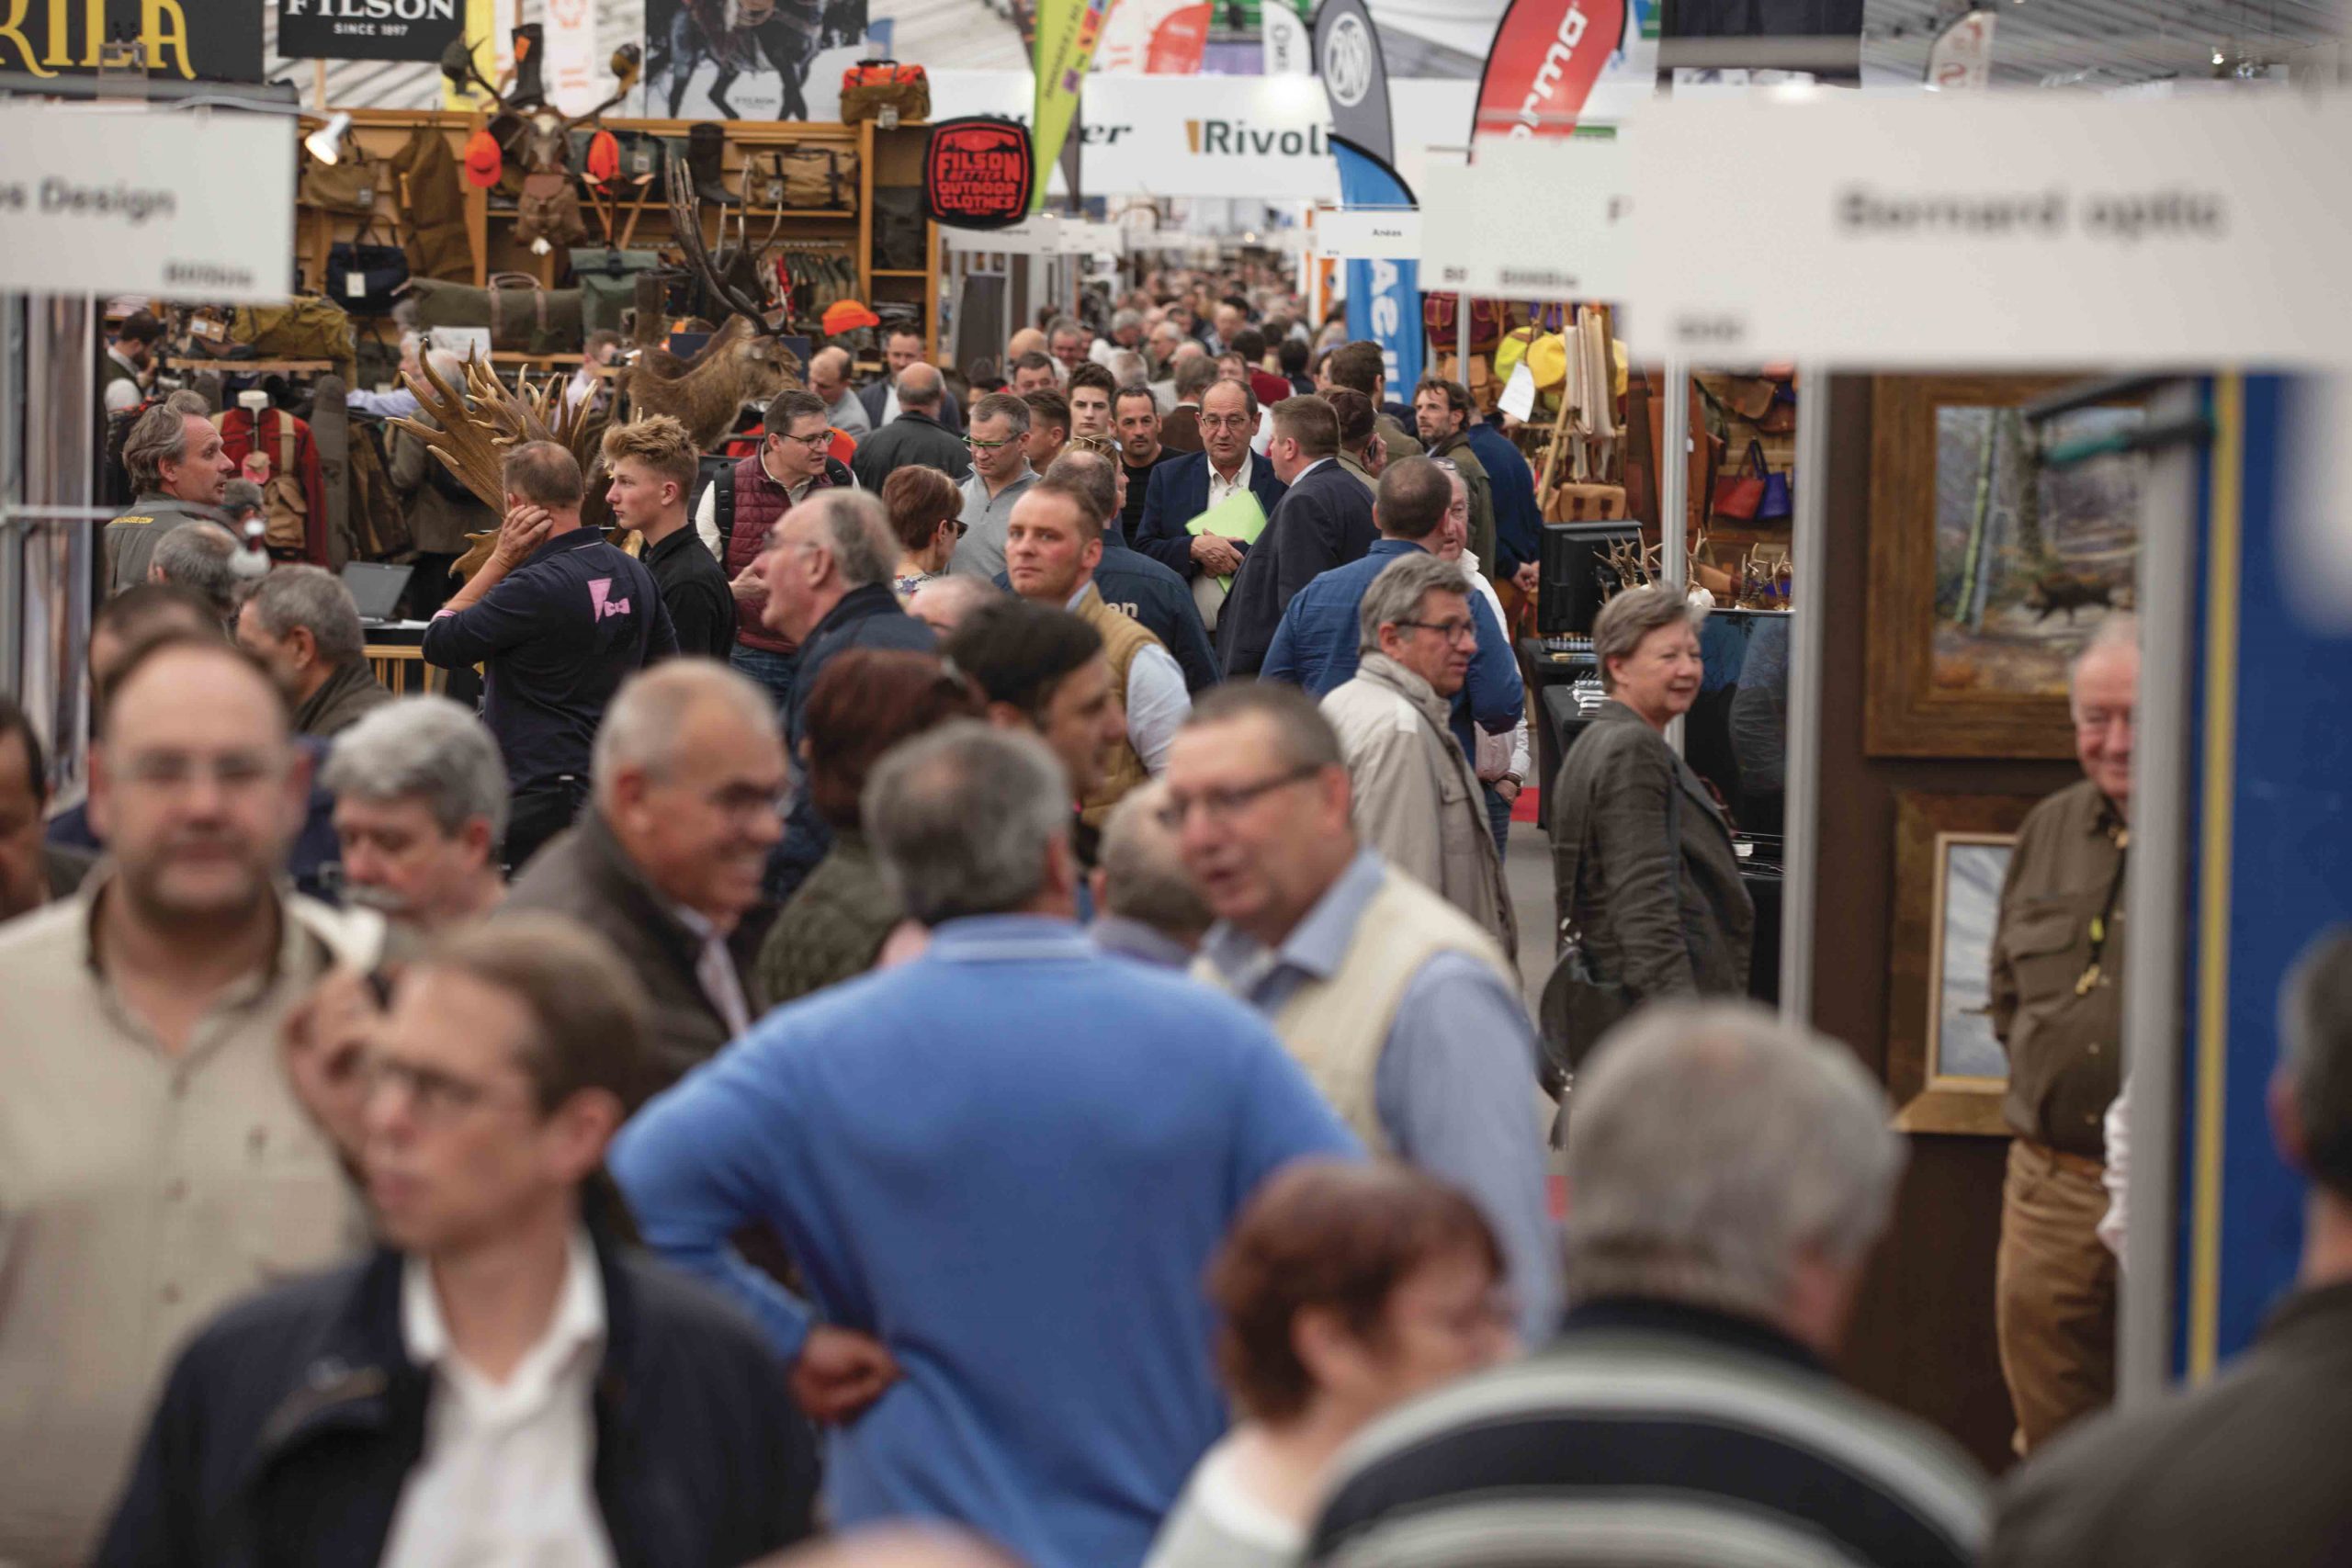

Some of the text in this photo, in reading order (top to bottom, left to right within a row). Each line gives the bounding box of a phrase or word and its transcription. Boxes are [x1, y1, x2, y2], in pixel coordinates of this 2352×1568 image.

[334, 23, 409, 36] SINCE 1897
[937, 152, 1021, 182] FILSON
[937, 182, 1017, 195] OUTDOOR
[40, 176, 175, 225] Design
[940, 195, 1016, 209] CLOTHES
